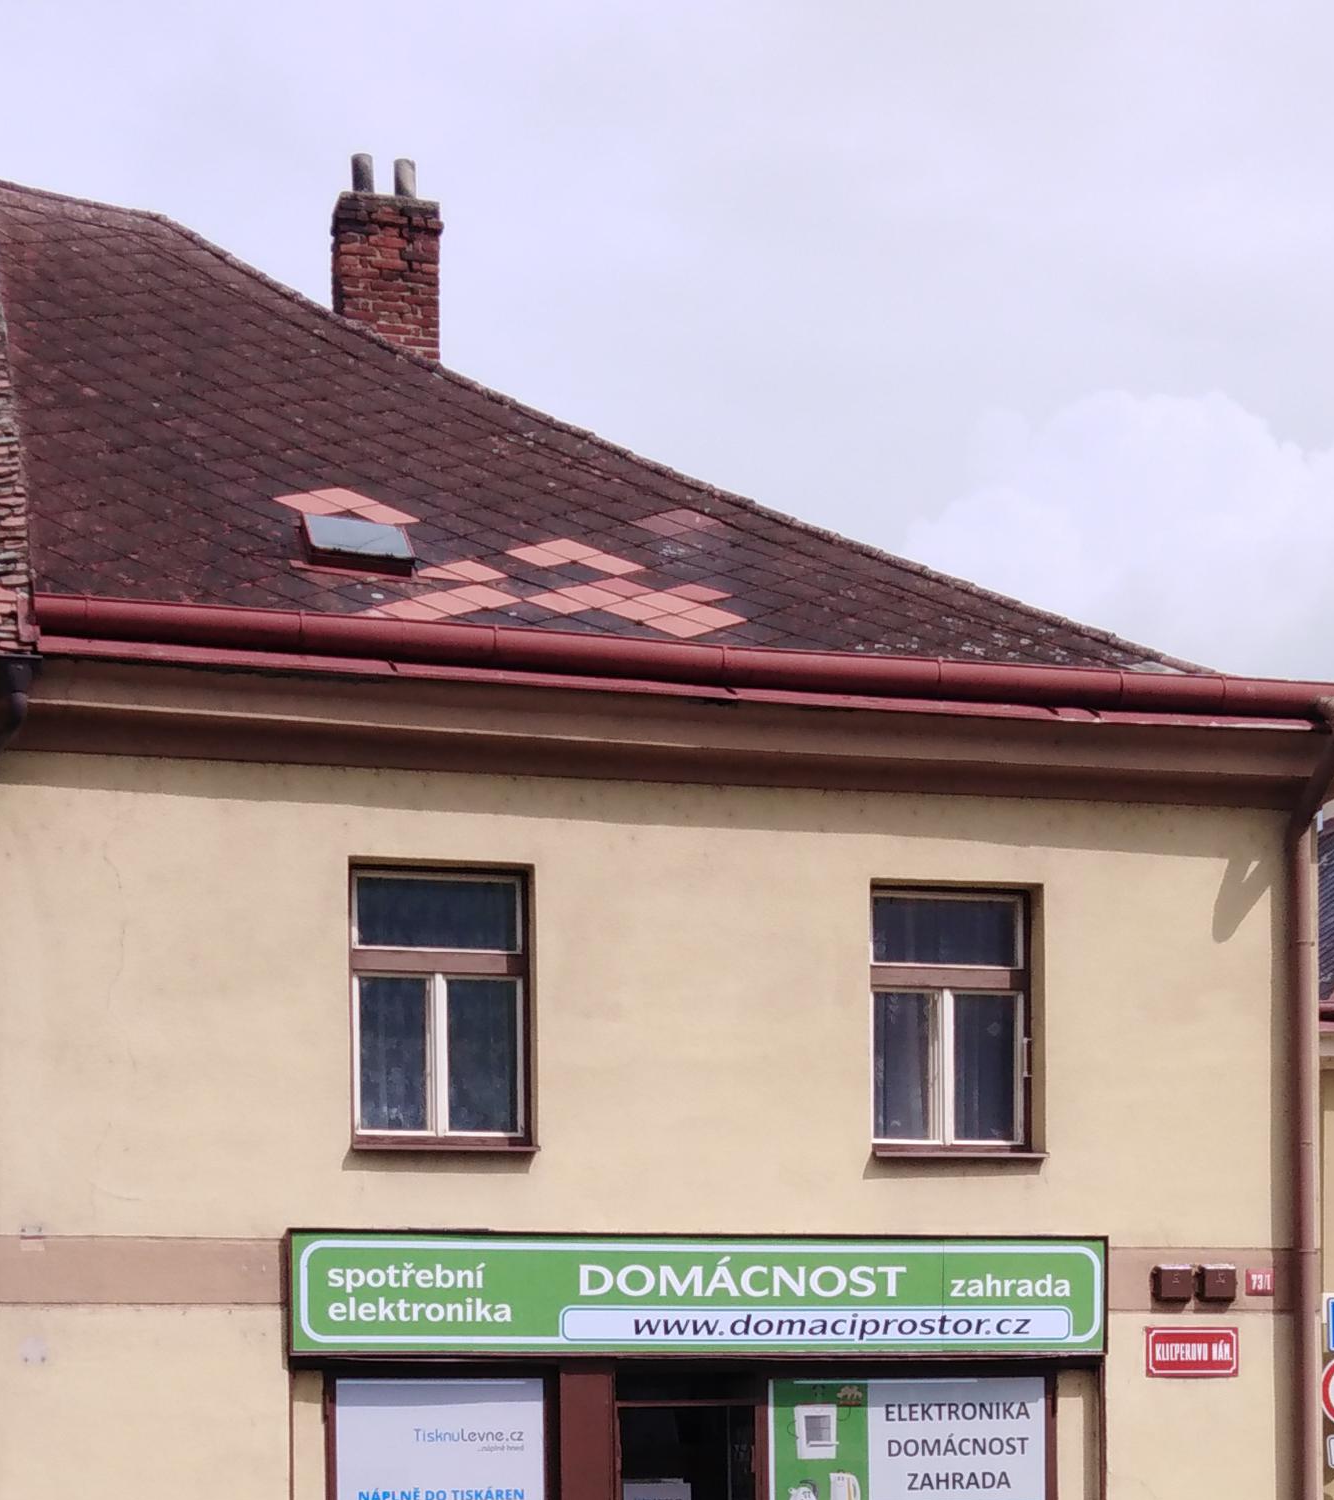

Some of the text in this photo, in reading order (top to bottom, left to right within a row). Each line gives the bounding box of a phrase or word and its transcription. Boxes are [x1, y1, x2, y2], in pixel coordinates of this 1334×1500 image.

[327, 1262, 486, 1293] spotřební
[578, 1256, 907, 1298] DOMÁCNOST
[949, 1272, 1071, 1298] zahrada
[327, 1297, 513, 1323] elektronika
[632, 1312, 1031, 1341] www.domaciprostor.cz
[1212, 1340, 1233, 1361] NÁM.
[885, 1401, 1031, 1422] ELEKTRONIKA
[413, 1428, 524, 1443] TisknuLevne.cz
[887, 1433, 1030, 1458] DOMÁCNOST
[907, 1471, 1012, 1491] ZAHRADA
